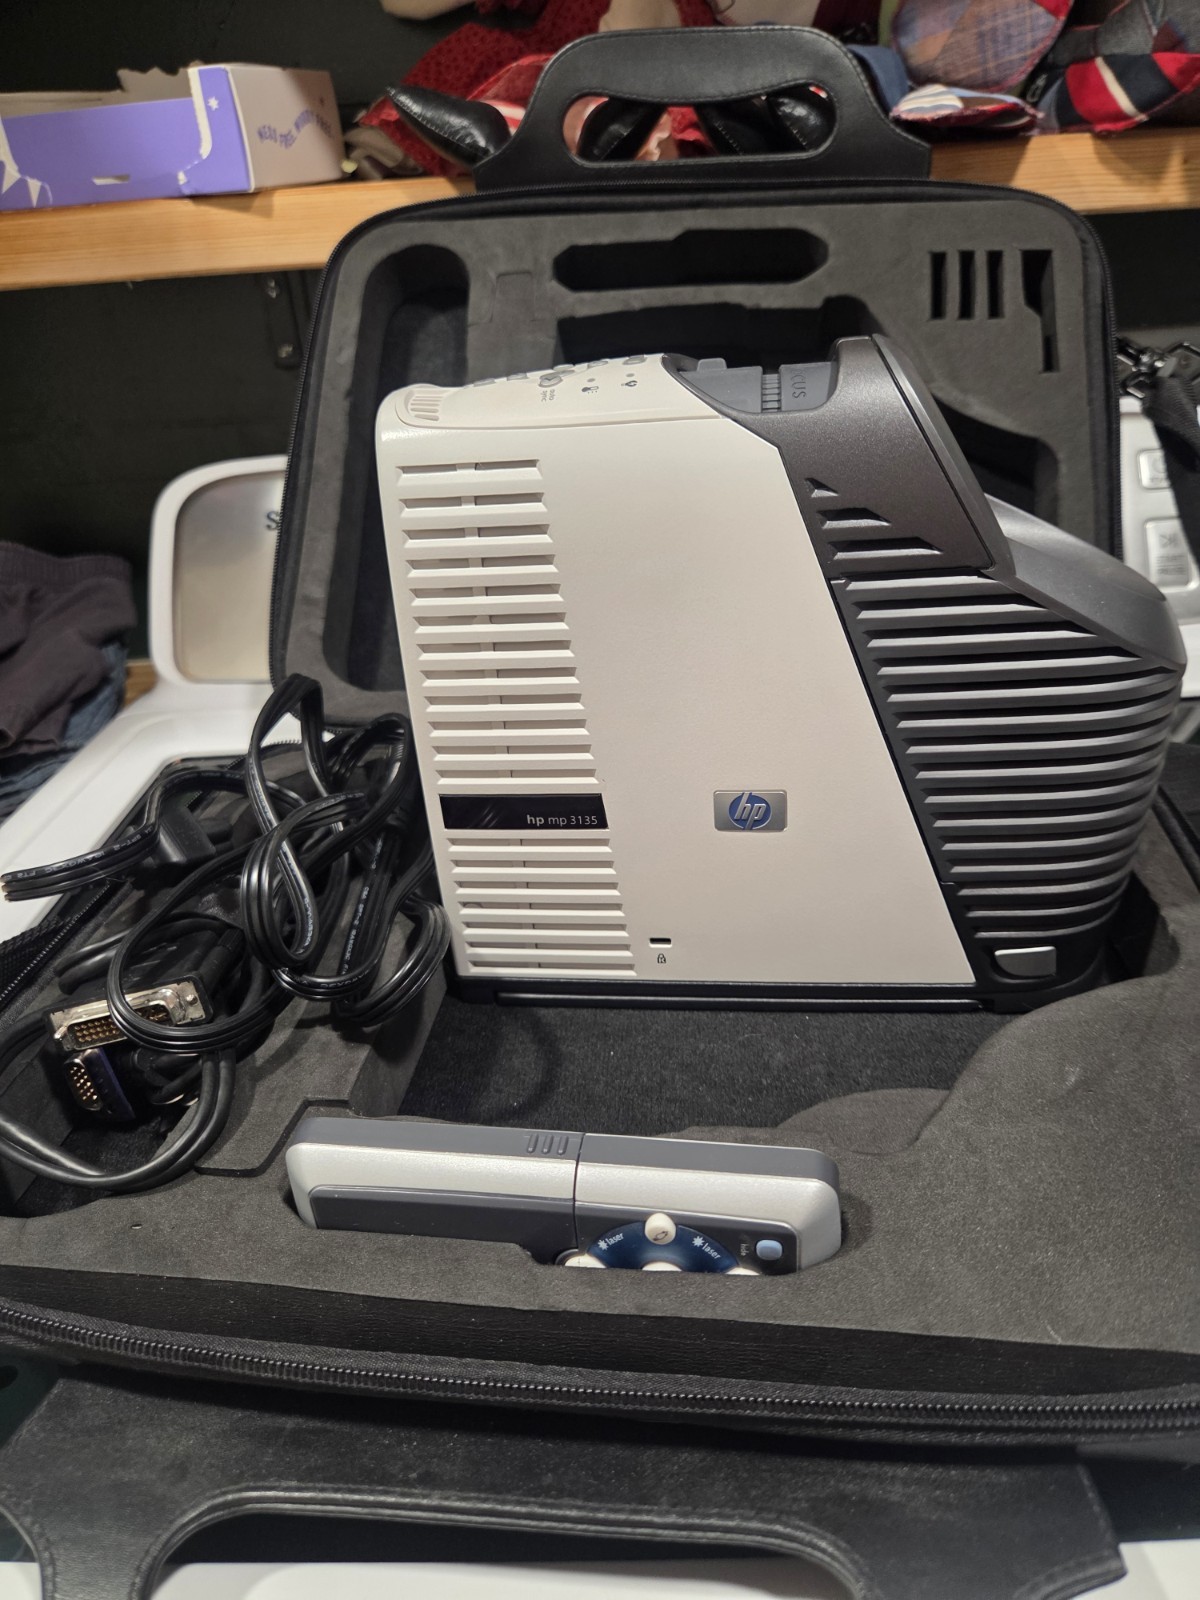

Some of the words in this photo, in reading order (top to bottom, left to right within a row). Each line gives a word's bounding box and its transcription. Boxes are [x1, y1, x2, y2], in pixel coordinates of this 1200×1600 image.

[732, 792, 768, 830] hp
[526, 814, 545, 827] hp
[548, 815, 568, 827] mp
[570, 815, 598, 826] 3135
[605, 1232, 625, 1248] laser
[701, 1241, 722, 1260] laser
